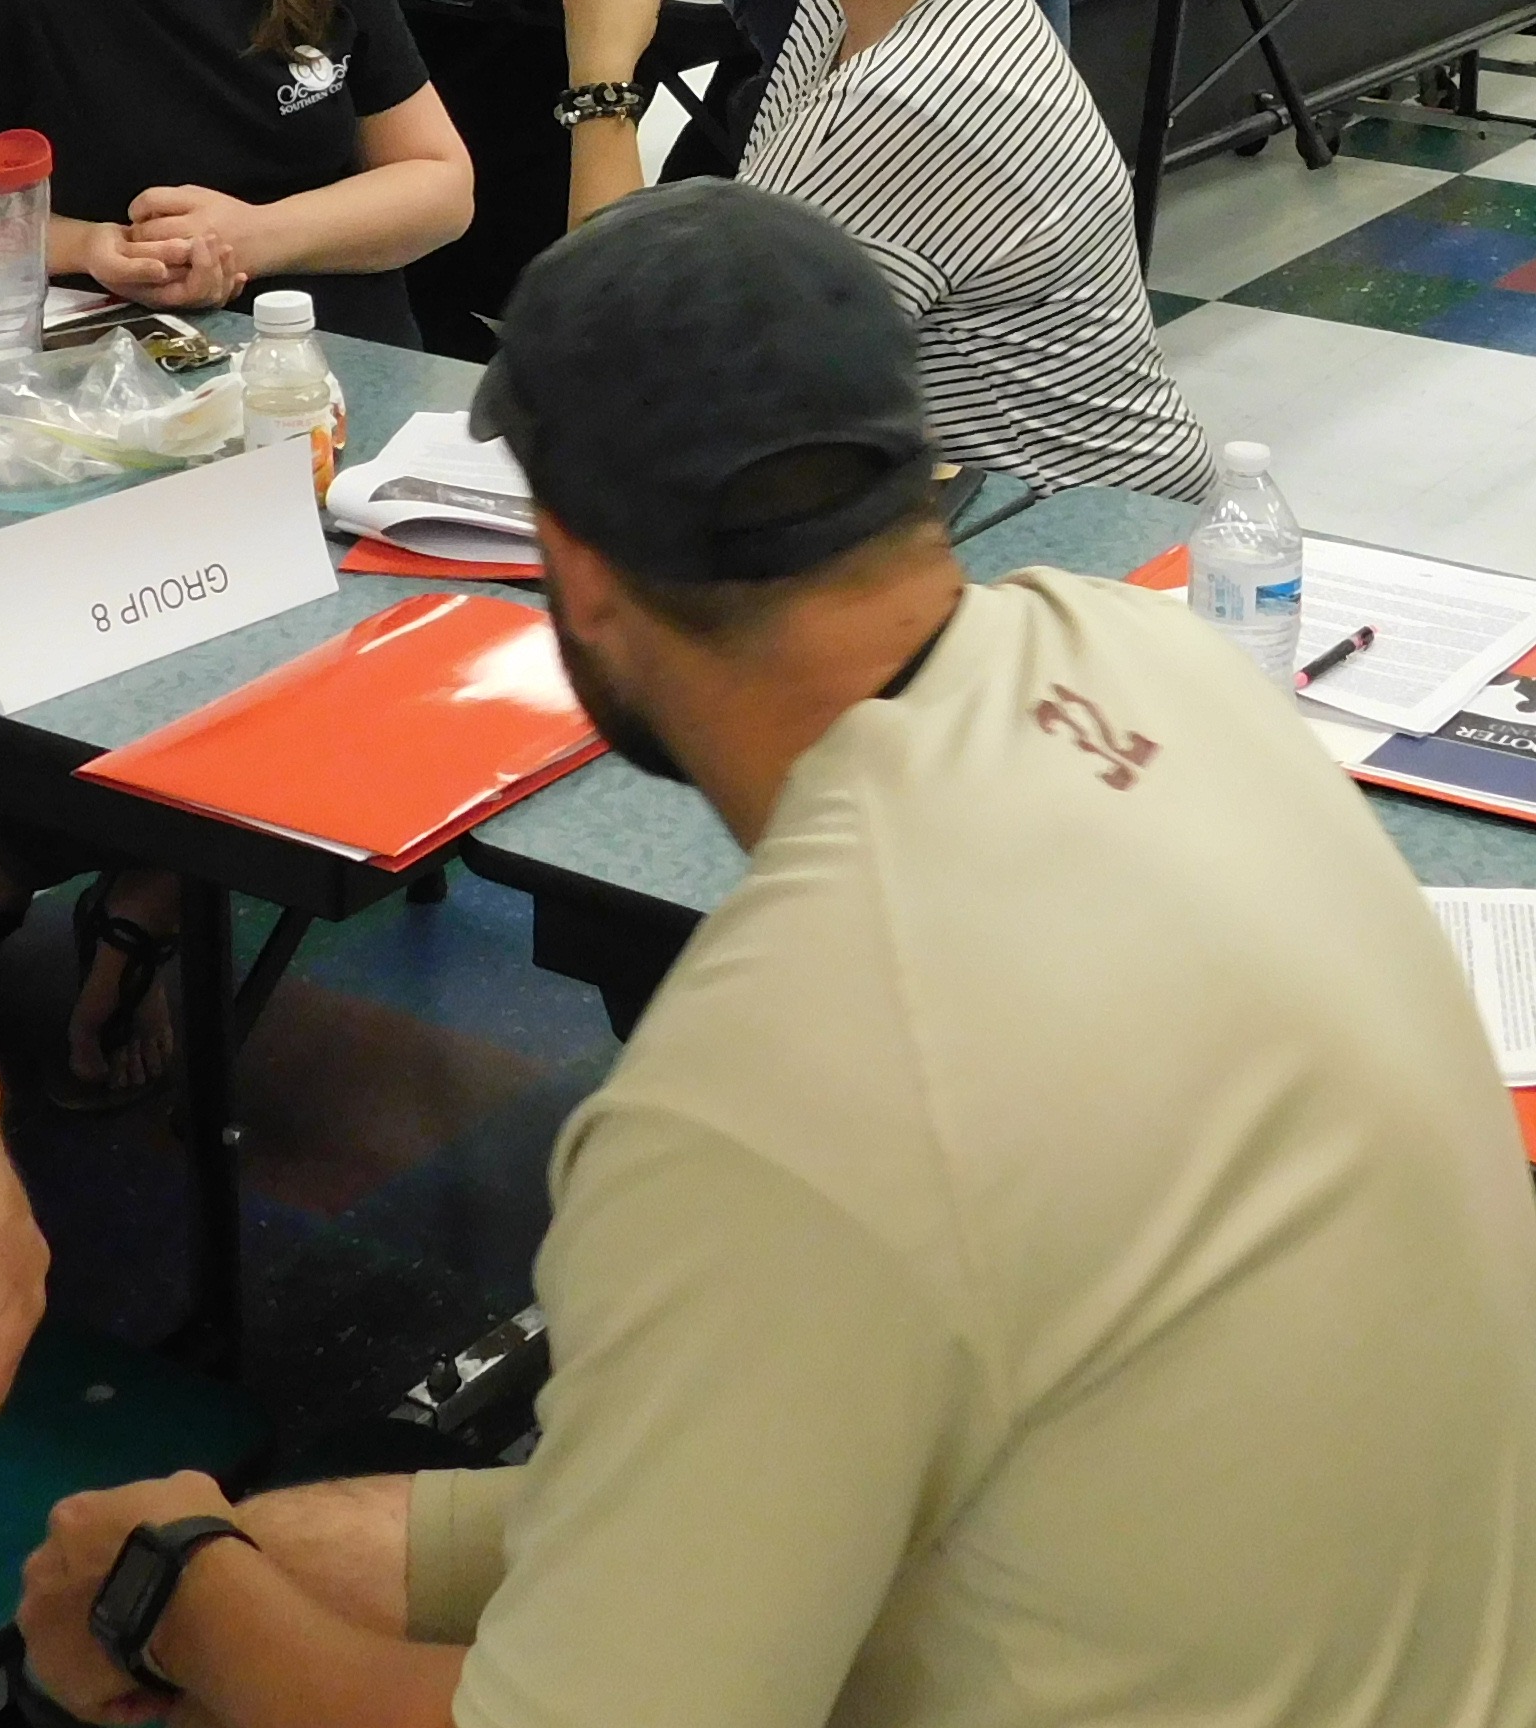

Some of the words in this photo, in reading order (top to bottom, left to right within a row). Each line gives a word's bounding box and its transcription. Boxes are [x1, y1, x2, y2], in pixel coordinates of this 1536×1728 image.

[279, 90, 329, 116] SOUTHERN
[120, 563, 228, 625] GROUP
[91, 603, 111, 633] 8
